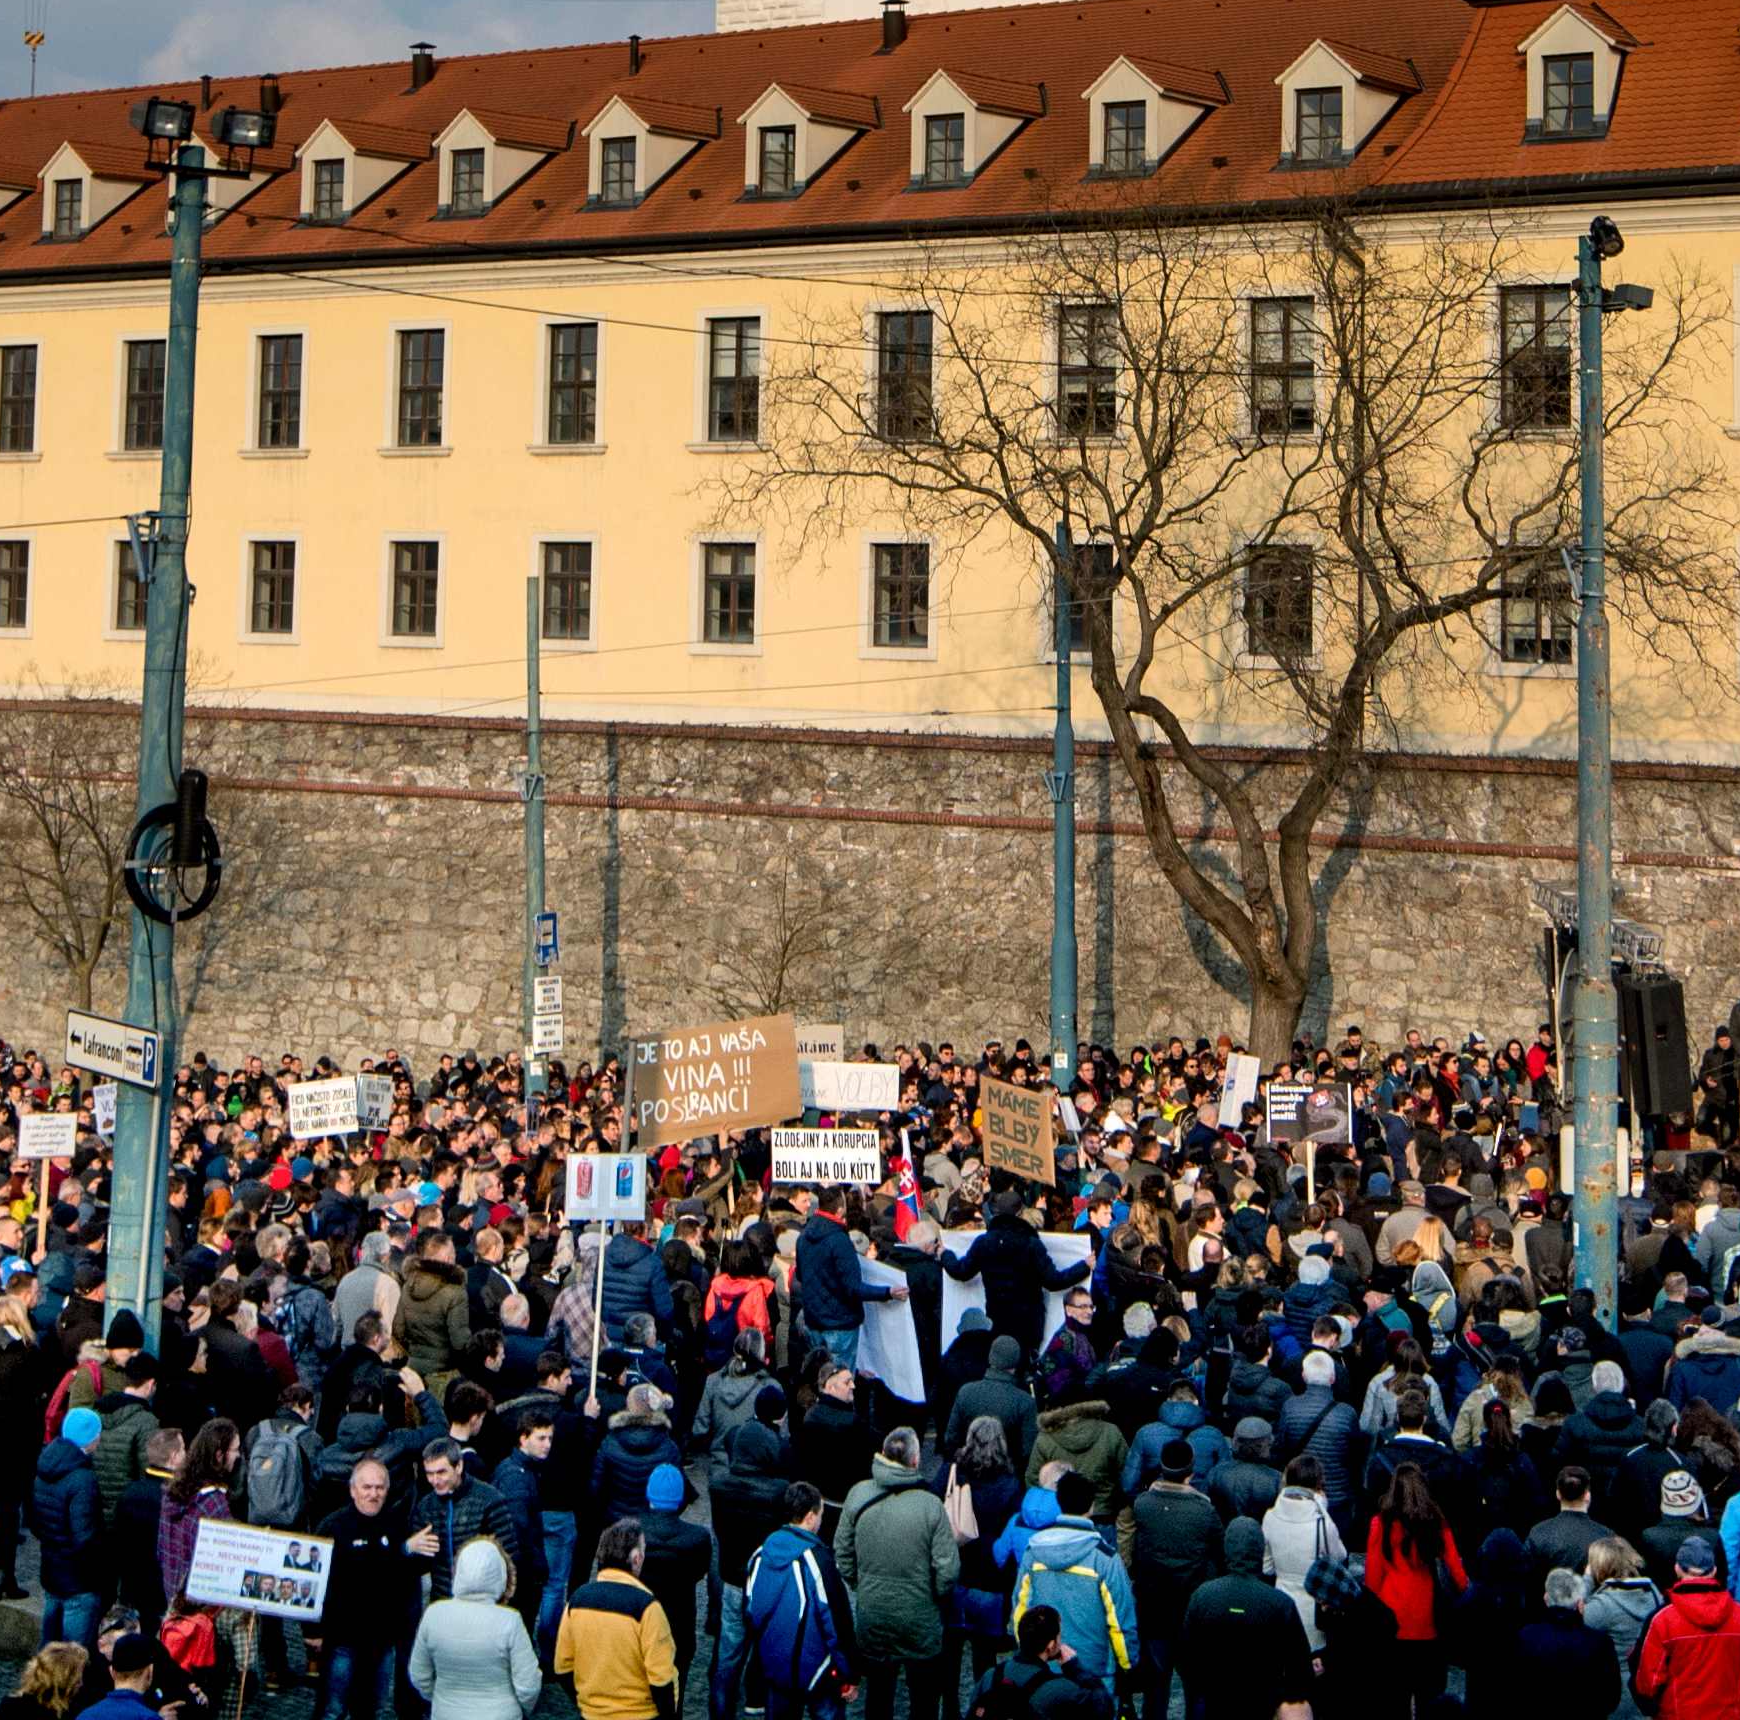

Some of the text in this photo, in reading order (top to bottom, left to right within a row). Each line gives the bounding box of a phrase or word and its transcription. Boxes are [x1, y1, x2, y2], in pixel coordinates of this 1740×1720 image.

[84, 1031, 123, 1065] Lafranconi
[637, 1026, 767, 1064] JE TO AJ VAŠA
[664, 1056, 751, 1092] VINA !!!
[988, 1086, 1040, 1119] MÁME
[774, 1132, 876, 1149] ZLODEJINY A KORUPCIA
[775, 1161, 797, 1178] BOLI
[800, 1161, 812, 1178] AJ
[816, 1162, 829, 1179] NA
[850, 1158, 875, 1180] KÚTY
[990, 1141, 1044, 1176] SMER
